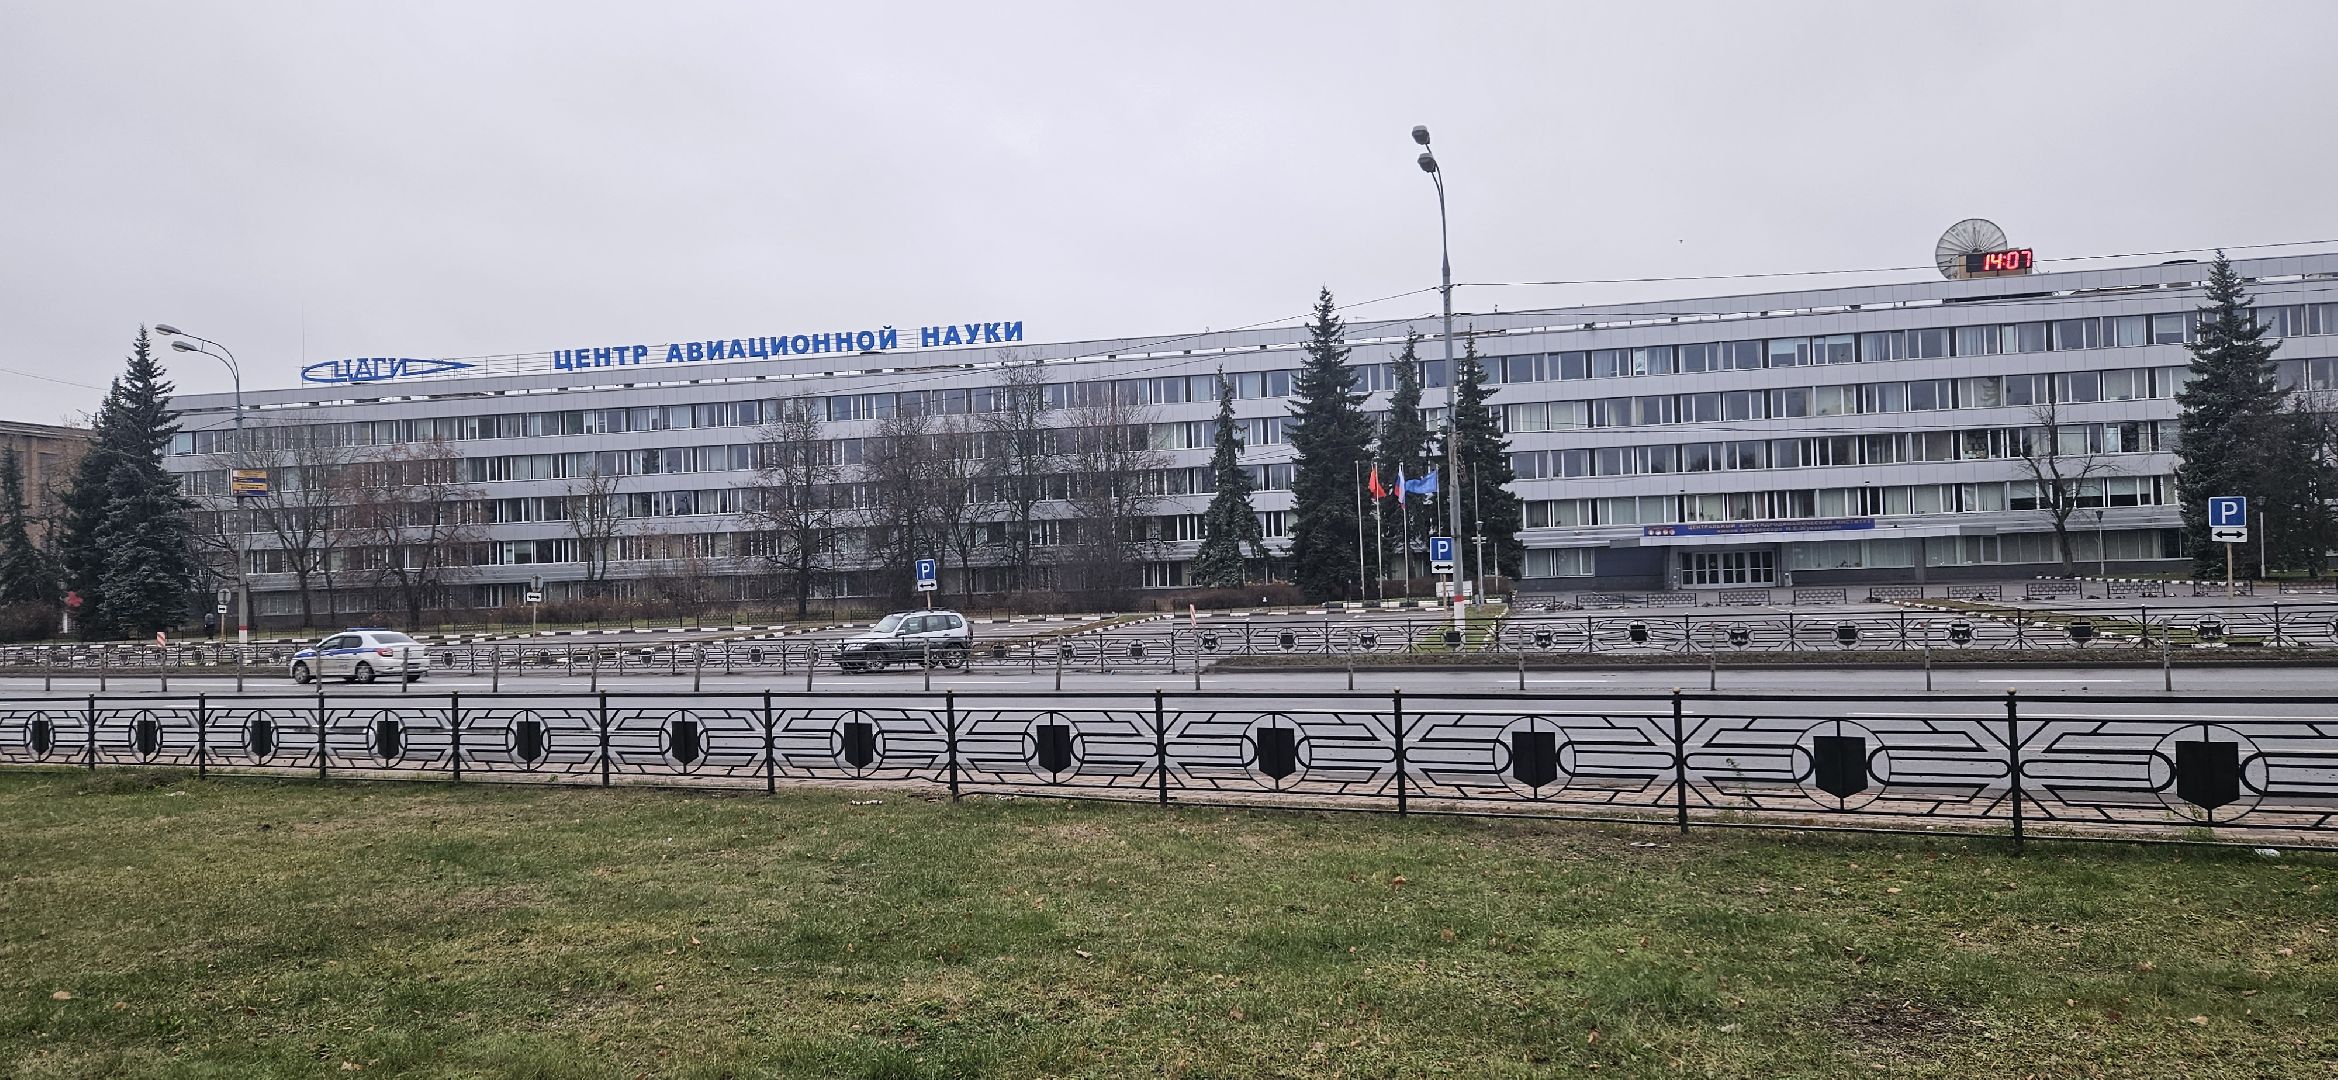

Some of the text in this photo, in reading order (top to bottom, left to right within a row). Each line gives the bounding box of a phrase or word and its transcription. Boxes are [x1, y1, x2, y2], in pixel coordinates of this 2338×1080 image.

[1984, 250, 2032, 271] 14:07
[553, 321, 1023, 371] ЦЕНТР АВИАЦИОННОЙ НАУКИ
[334, 357, 408, 382] ЦАГИ
[2221, 501, 2238, 525] P
[1438, 540, 1449, 560] P
[921, 562, 930, 579] P
